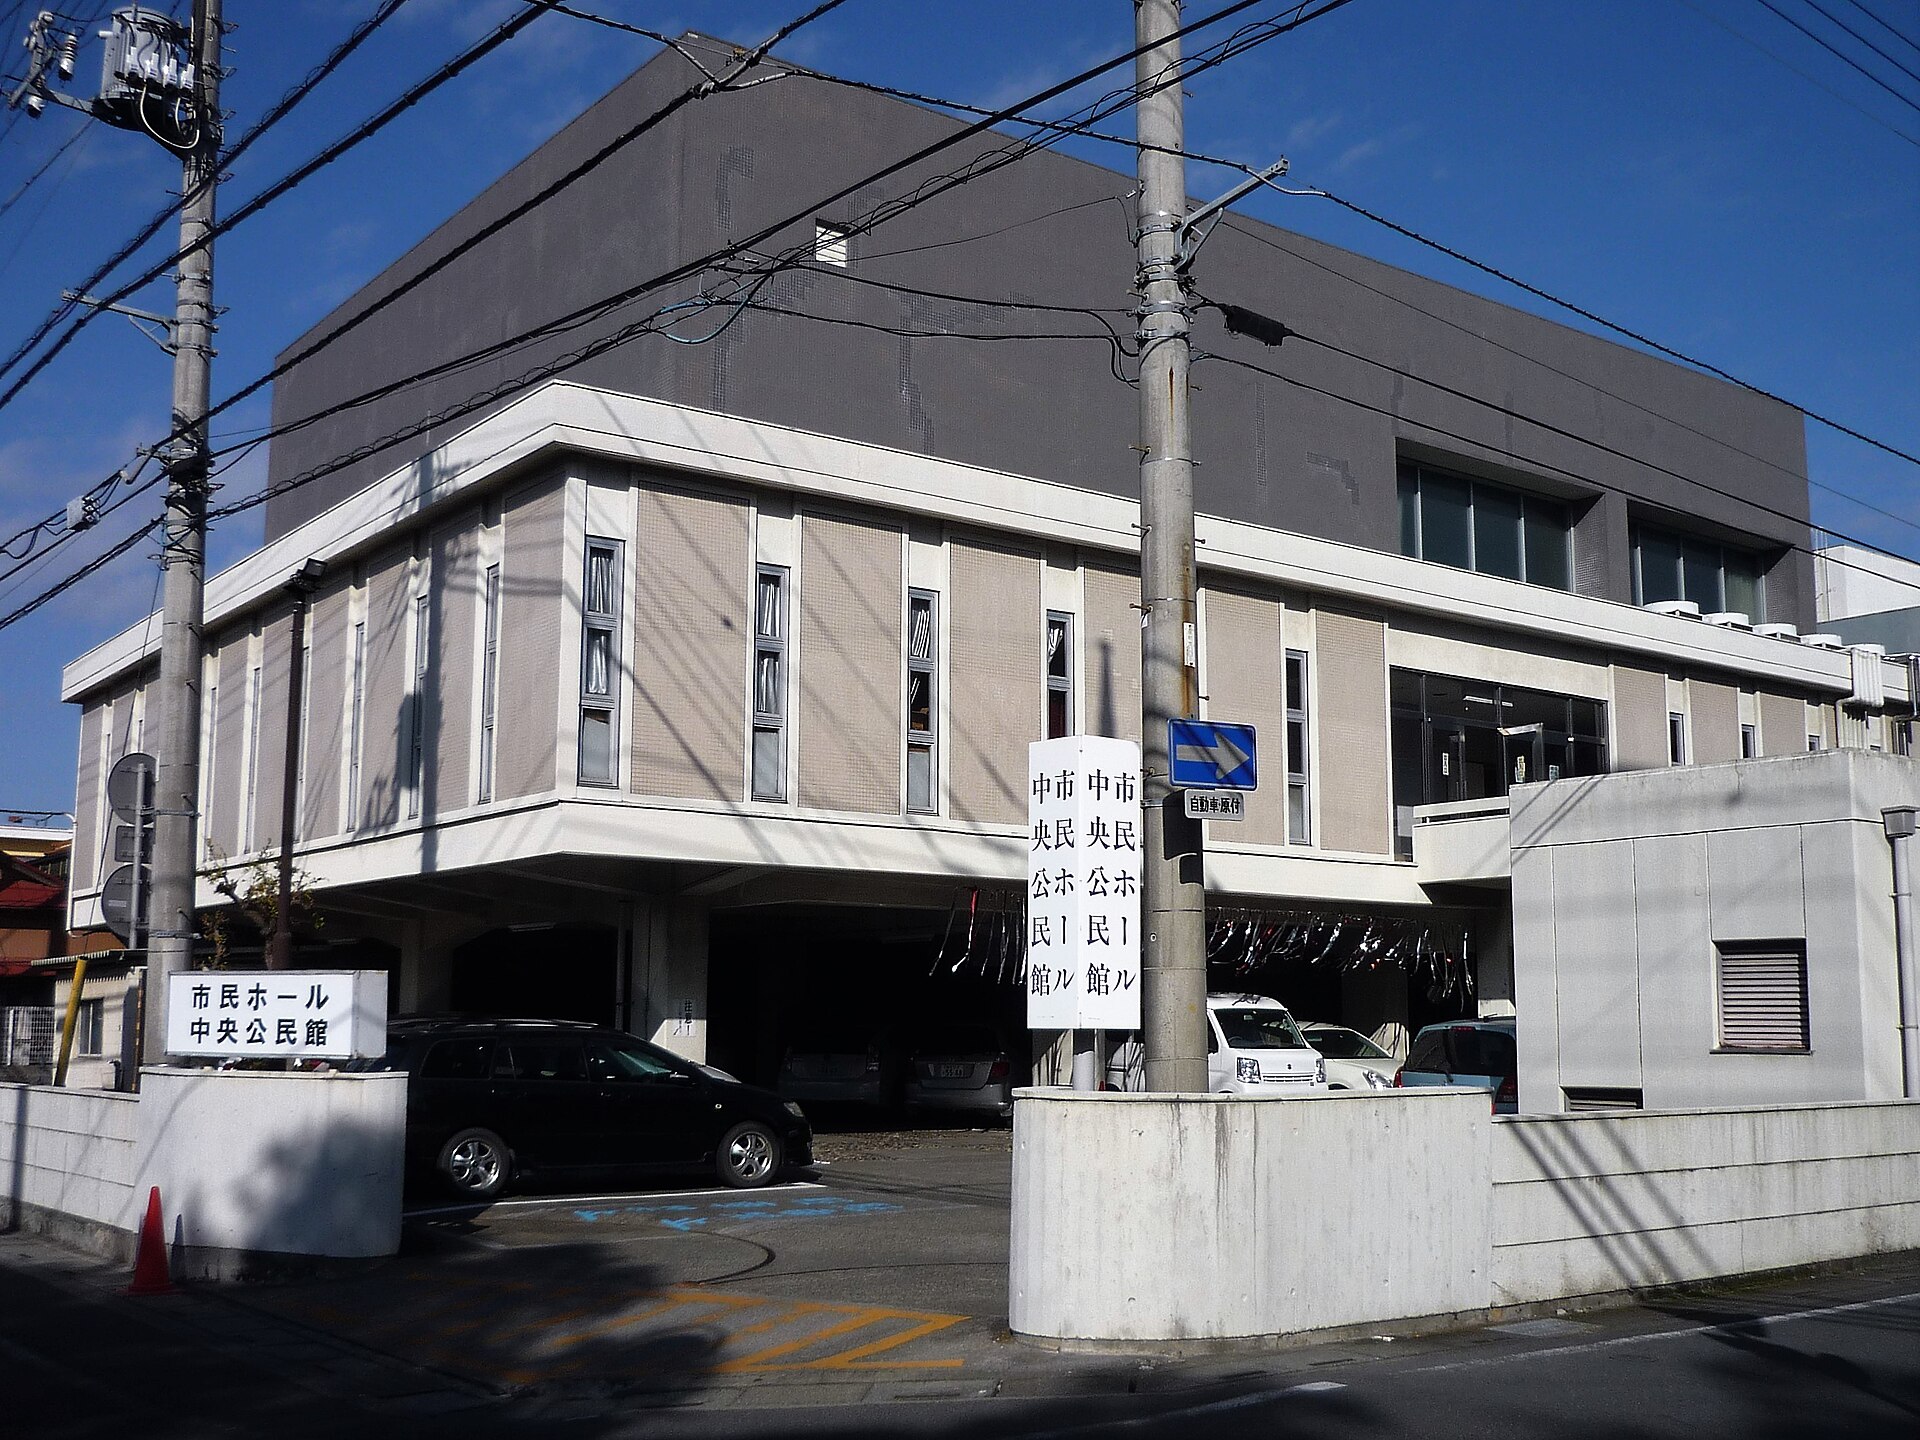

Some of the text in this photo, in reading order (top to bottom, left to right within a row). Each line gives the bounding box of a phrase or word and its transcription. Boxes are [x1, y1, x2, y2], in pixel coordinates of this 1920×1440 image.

[1030, 772, 1051, 996] 中央公民館
[1053, 769, 1075, 992] 市民ホール
[1086, 769, 1111, 996] 中央公民館
[1113, 772, 1137, 991] 市民ホール
[1190, 795, 1240, 814] 自動車・原付
[190, 1017, 329, 1047] 中央公民館
[191, 982, 330, 1011] 市民ホール
